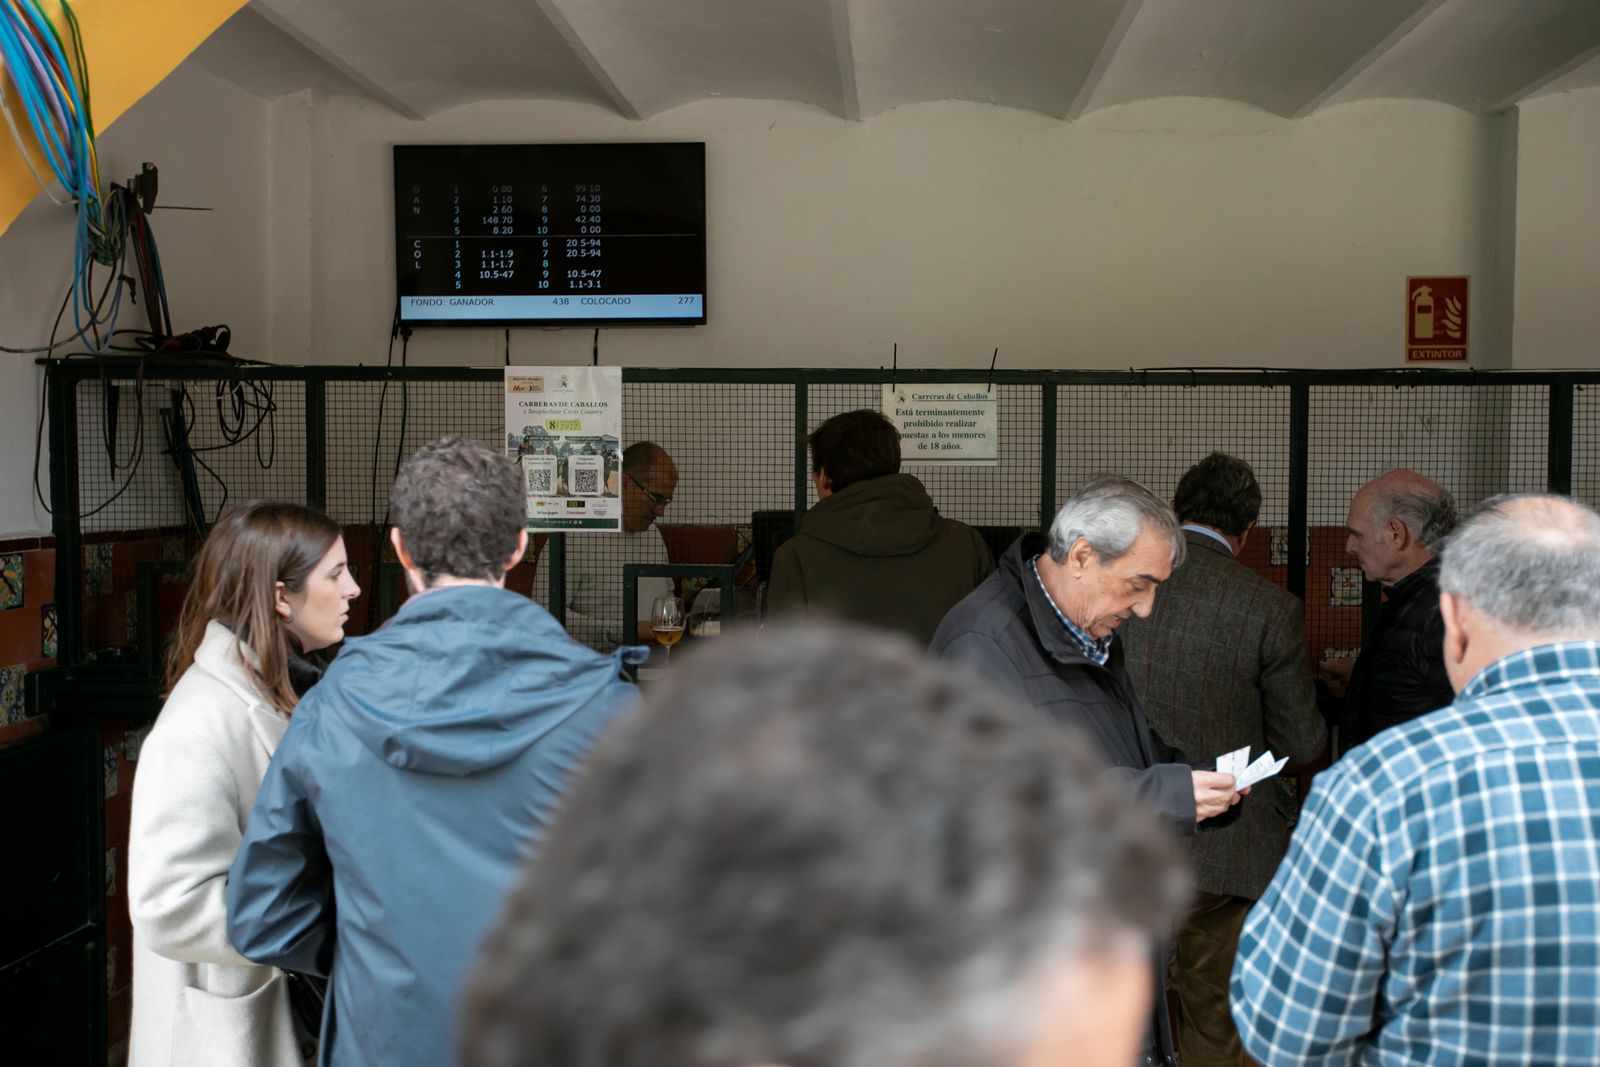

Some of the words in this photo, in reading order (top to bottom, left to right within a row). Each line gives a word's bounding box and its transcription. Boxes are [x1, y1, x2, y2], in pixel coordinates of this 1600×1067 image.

[454, 196, 460, 204] 2
[493, 196, 513, 204] 1.10
[492, 206, 513, 214] 2.60
[482, 216, 513, 224] 148.70
[454, 227, 460, 235] 5
[492, 226, 514, 235] 8.20
[537, 226, 548, 234] 10
[566, 239, 601, 247] 20.5-94
[482, 250, 514, 258] 1.1-1.9
[566, 249, 601, 257] 20.5-94
[455, 260, 461, 268] 3
[482, 260, 514, 268] 1.1-1.7
[480, 270, 514, 279] 10.5-47
[567, 270, 602, 278] 10.5-47
[455, 281, 462, 290] 5
[1412, 350, 1462, 359] EXTINTOR
[550, 420, 556, 430] 8
[903, 420, 943, 429] prohibido
